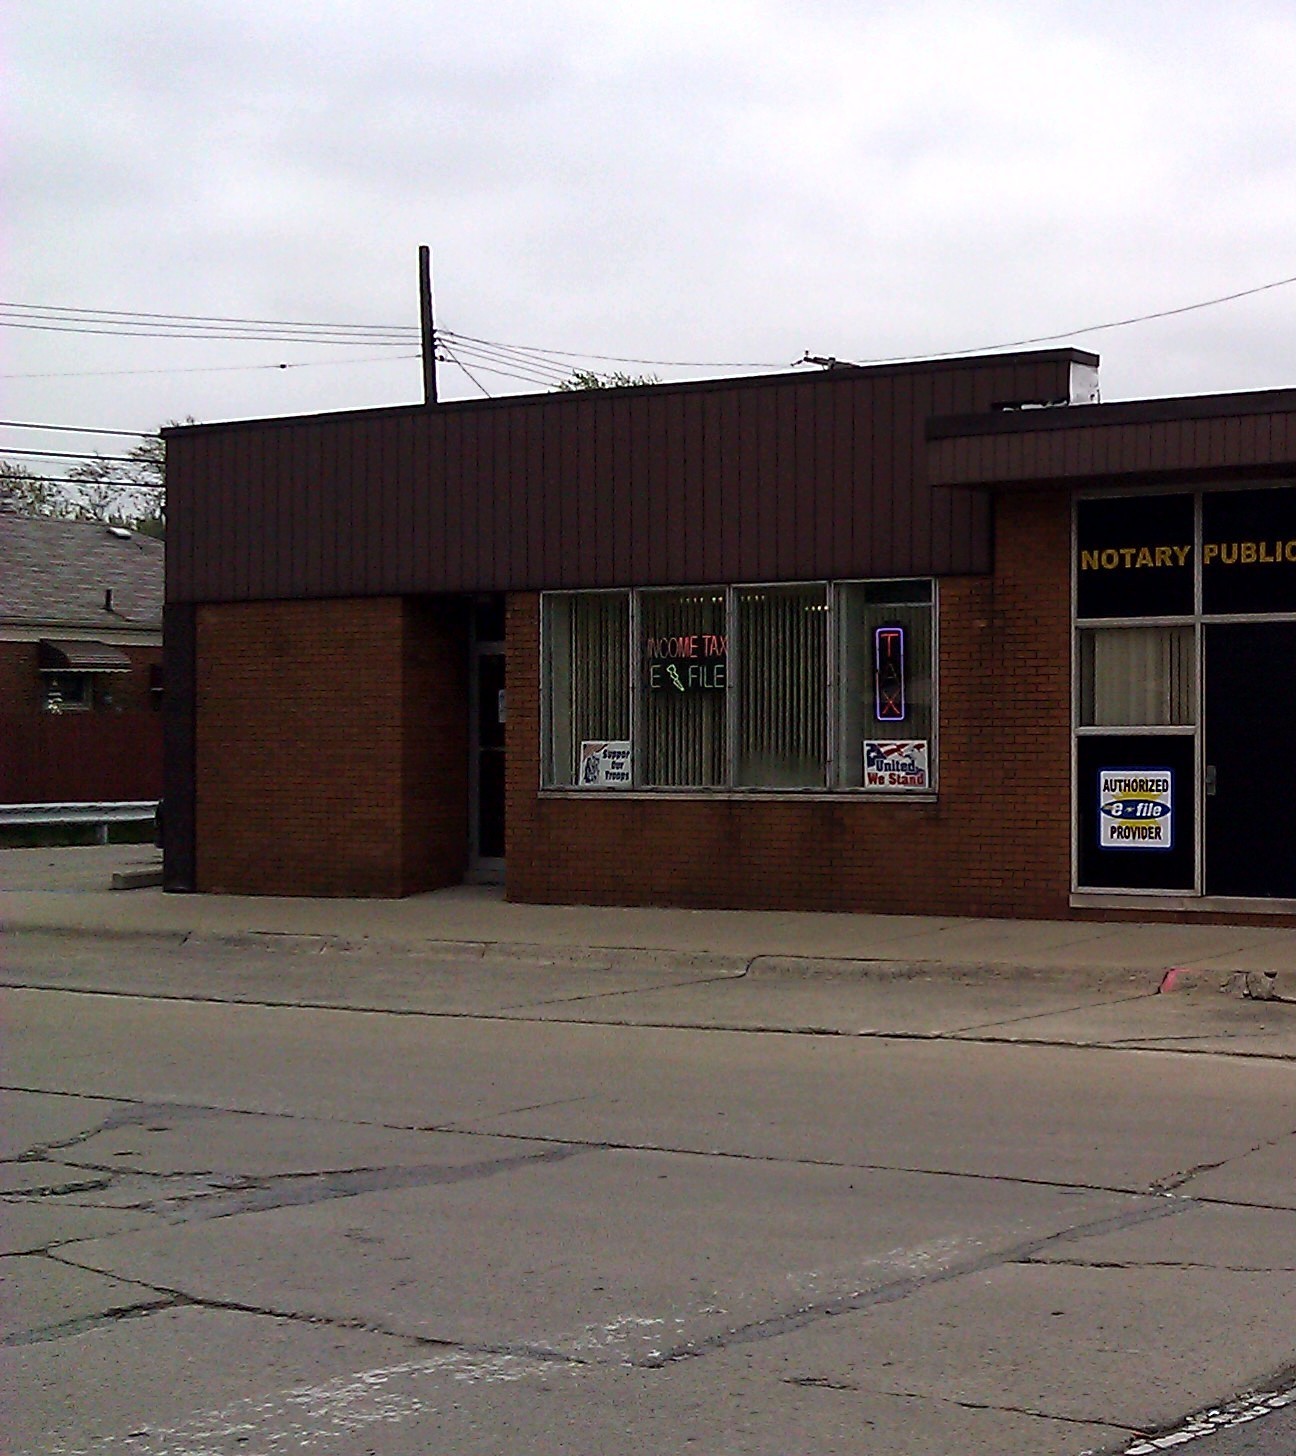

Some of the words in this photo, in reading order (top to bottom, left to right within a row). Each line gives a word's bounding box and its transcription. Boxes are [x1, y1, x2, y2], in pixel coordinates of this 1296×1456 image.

[1081, 545, 1191, 570] NOTARY
[647, 636, 699, 658] INCOME
[702, 635, 728, 657] TAX
[650, 665, 661, 688] E
[689, 665, 725, 688] FILE
[876, 759, 915, 772] United
[867, 773, 885, 785] We
[888, 772, 924, 785] Stand
[1103, 779, 1169, 792] AUTHORIZED
[1110, 826, 1162, 840] PROVIDER
